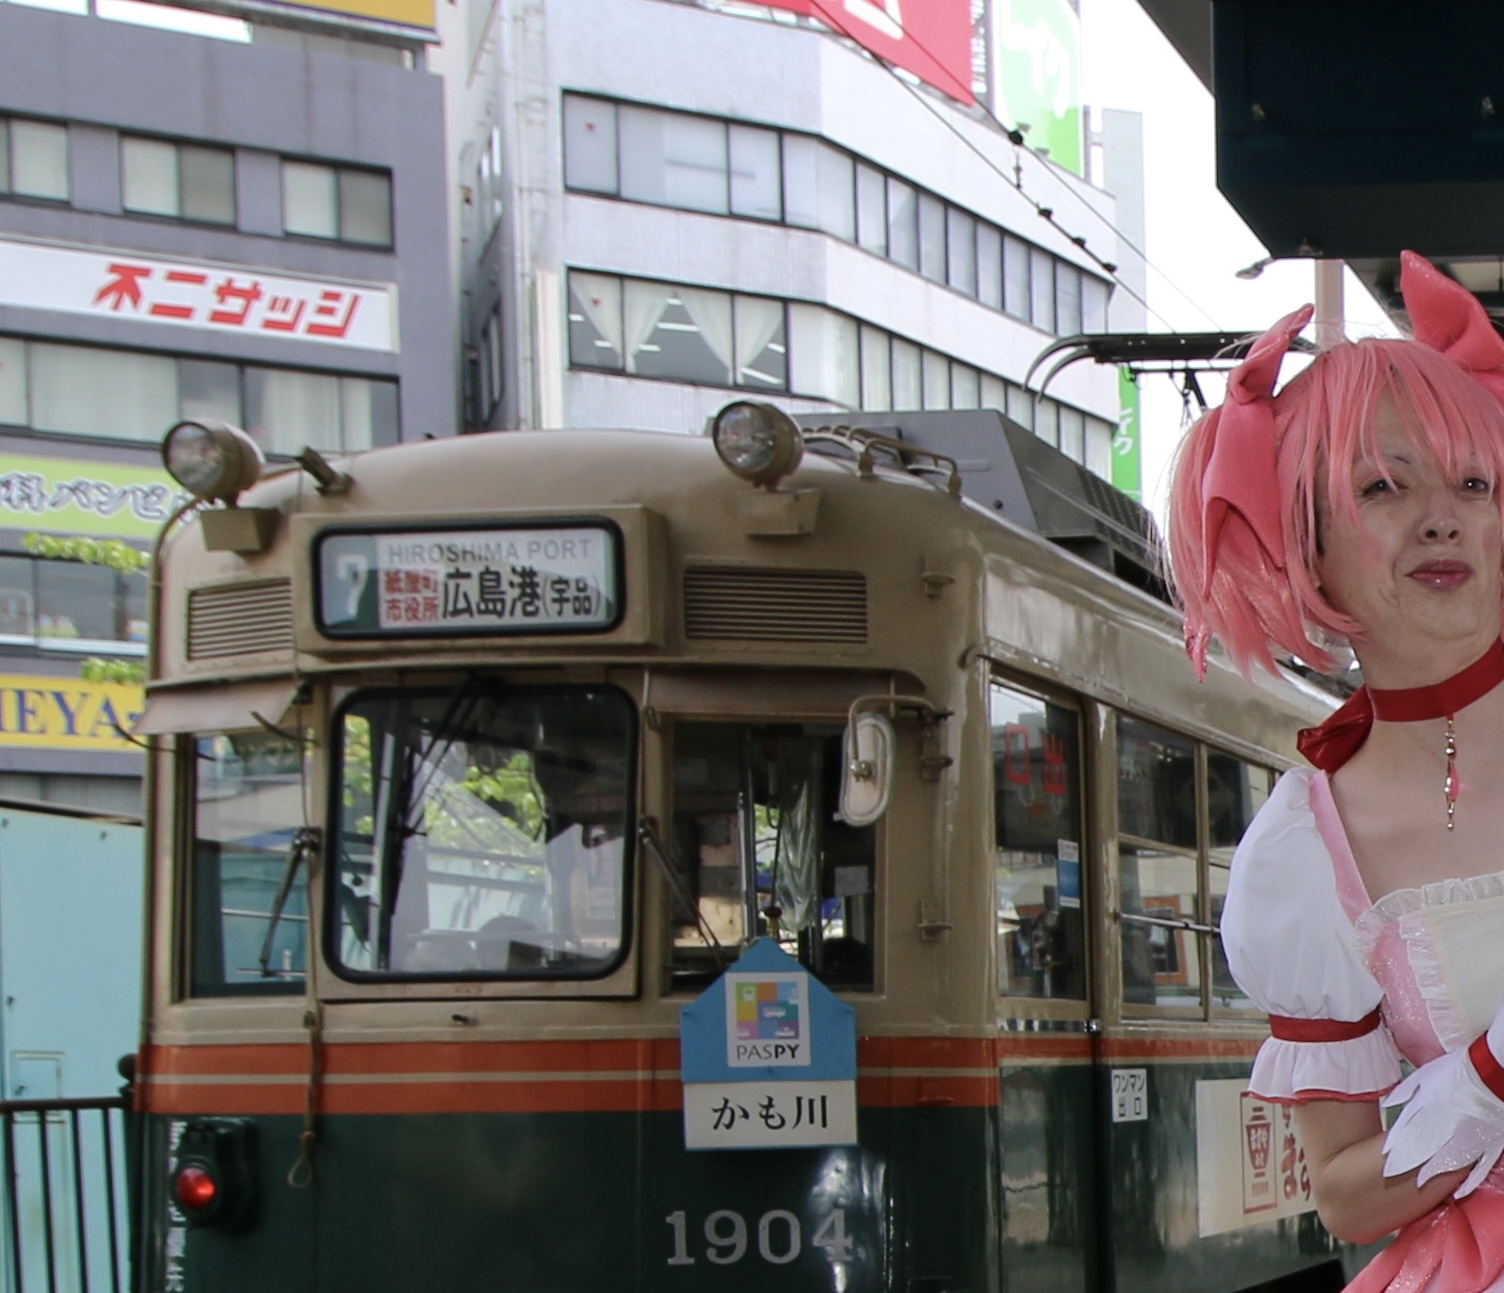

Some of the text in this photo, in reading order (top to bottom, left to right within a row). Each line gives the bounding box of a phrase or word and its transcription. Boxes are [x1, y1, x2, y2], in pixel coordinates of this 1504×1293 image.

[388, 540, 591, 563] HIROSHIMA PORT
[385, 597, 439, 622] 市役所
[0, 688, 126, 738] EYA
[736, 1044, 800, 1061] PASPY
[1113, 1074, 1146, 1093] ワンマン
[711, 1095, 828, 1131] かも川
[665, 1209, 854, 1266] 1904
